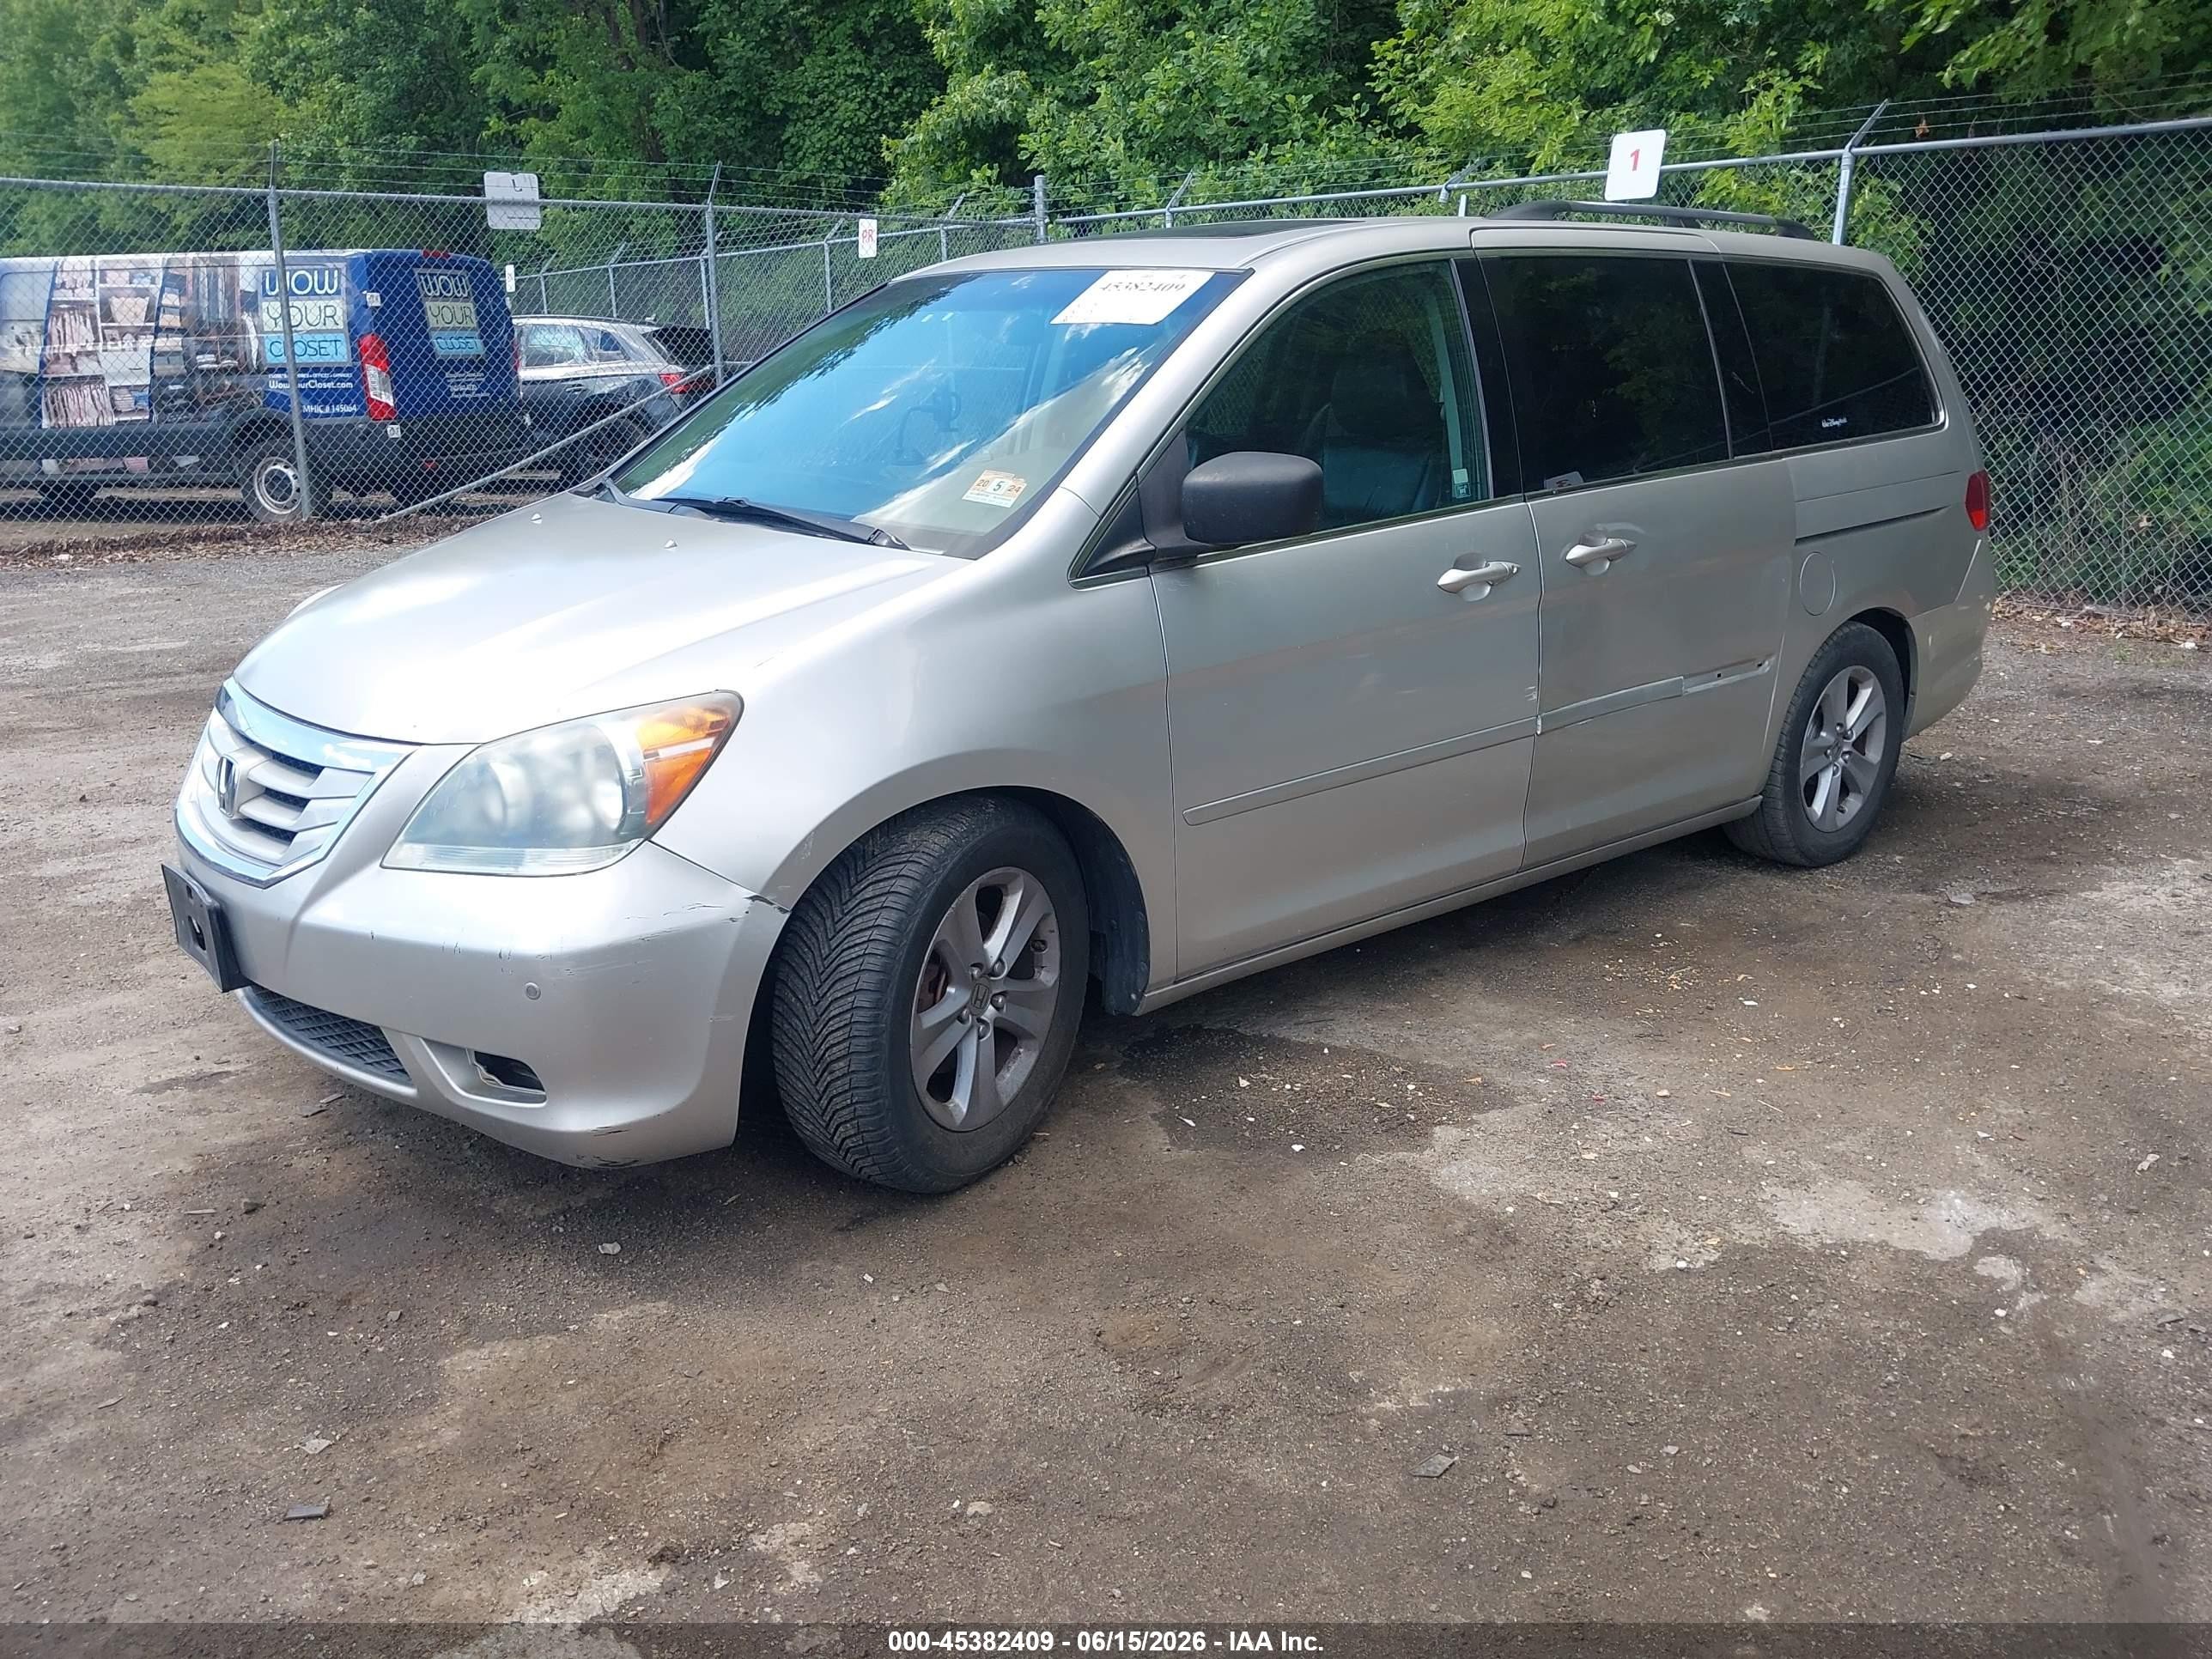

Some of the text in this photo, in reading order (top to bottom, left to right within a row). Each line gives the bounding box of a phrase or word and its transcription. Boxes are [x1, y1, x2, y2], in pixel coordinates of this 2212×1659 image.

[1630, 149, 1640, 172] 1
[265, 270, 338, 296] WOW
[420, 275, 469, 297] WOW
[266, 305, 339, 328] YOUR
[429, 305, 475, 325] YOUR
[436, 336, 479, 350] CLOSET
[975, 479, 1022, 494] 20 5 24
